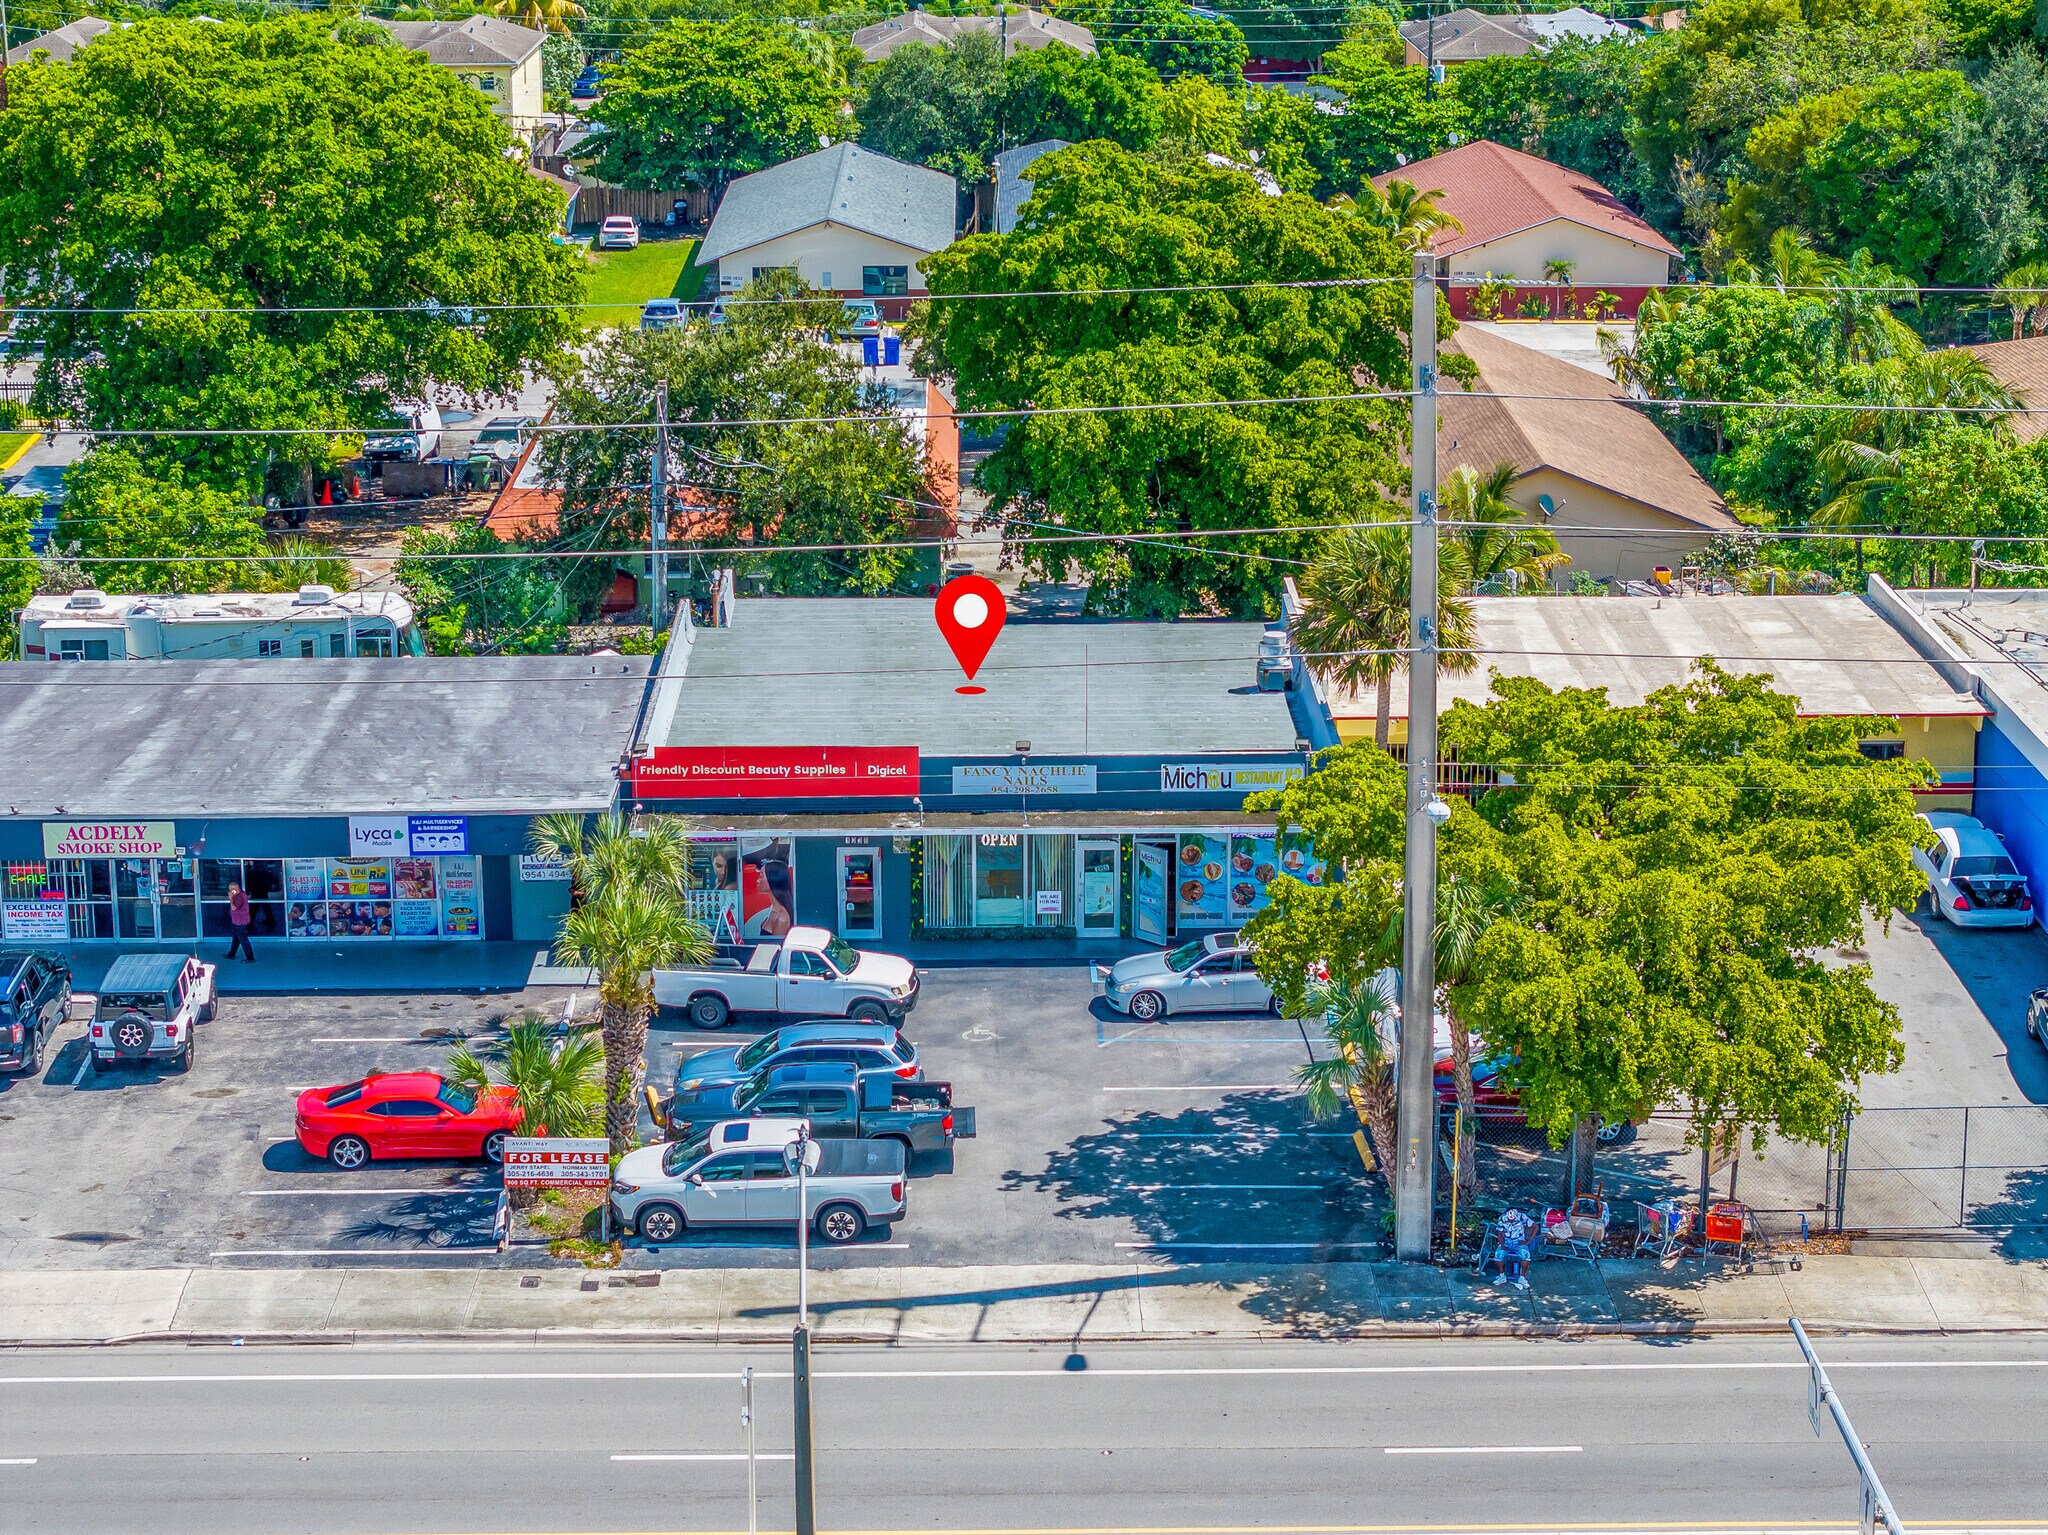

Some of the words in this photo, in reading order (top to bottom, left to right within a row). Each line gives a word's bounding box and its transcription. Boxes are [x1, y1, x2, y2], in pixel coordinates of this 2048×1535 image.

[640, 765, 688, 778] Friendly
[692, 765, 745, 775] Discount
[748, 765, 790, 778] Beauty
[794, 765, 846, 777] Supplies
[868, 765, 907, 778] Digicel
[963, 767, 1014, 777] FANCY
[1019, 766, 1086, 776] NACHLIE
[1236, 771, 1283, 784] RESTAURANT
[1004, 777, 1048, 785] NAILS
[66, 825, 148, 840] ACDELY
[356, 828, 391, 842] Lyca
[981, 834, 1017, 846] OPEN
[57, 843, 115, 854] SMOKE
[119, 842, 162, 853] SHOP
[369, 869, 386, 879] Ria
[509, 1154, 542, 1162] FOR
[551, 1154, 604, 1163] LEASE
